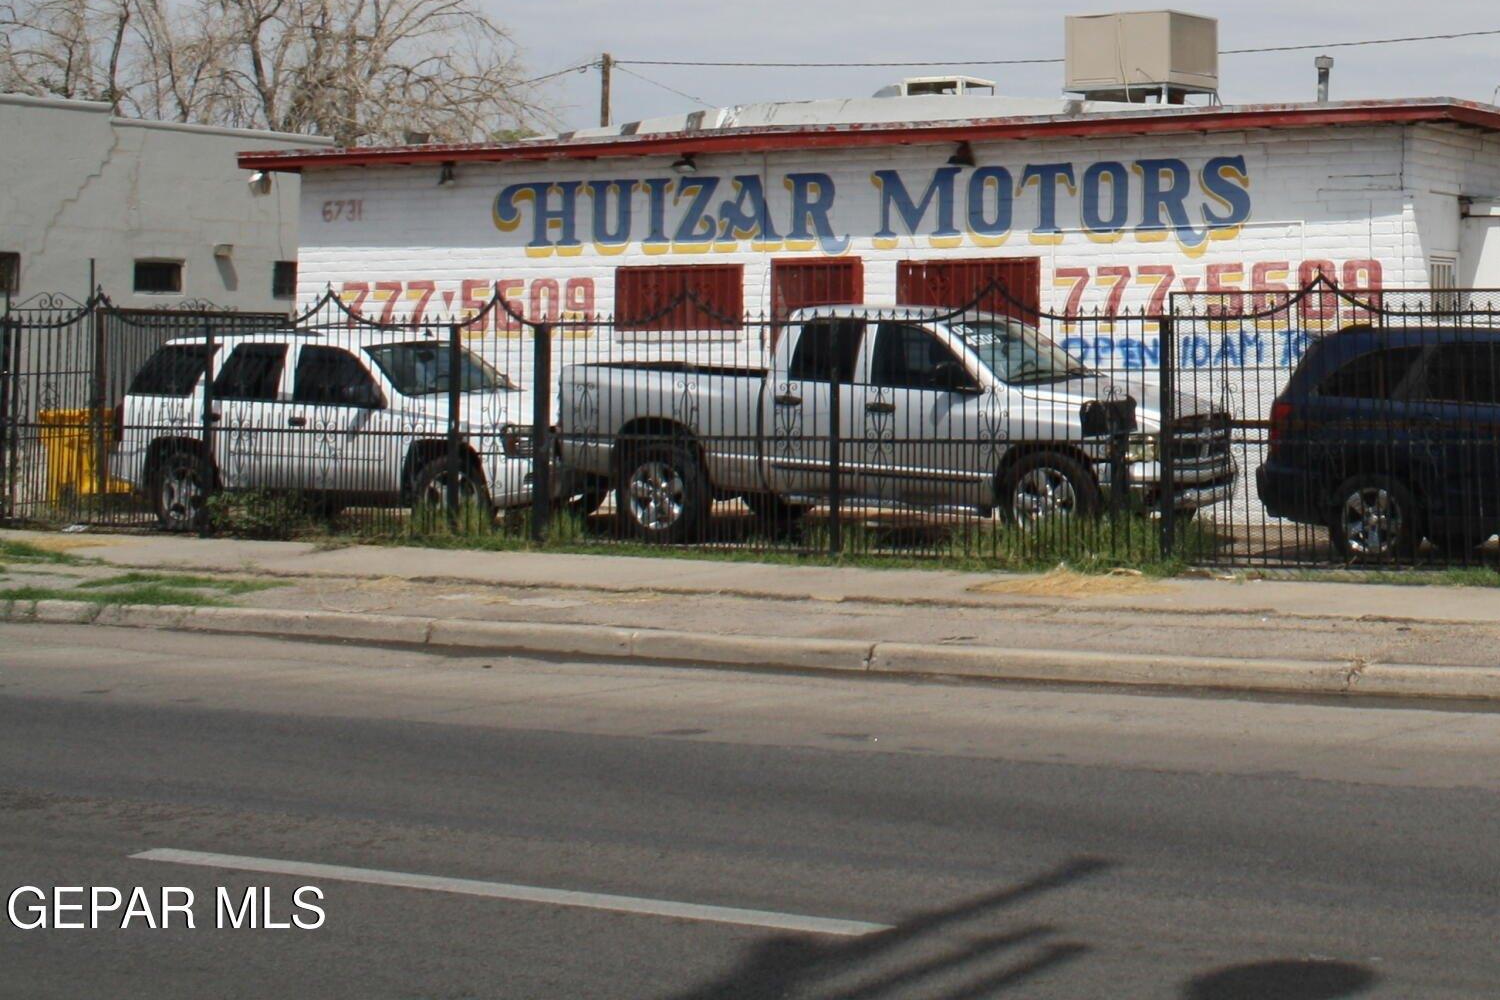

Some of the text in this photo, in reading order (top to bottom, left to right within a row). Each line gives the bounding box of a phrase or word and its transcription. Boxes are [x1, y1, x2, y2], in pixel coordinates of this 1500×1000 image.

[321, 200, 363, 222] 6731
[492, 155, 1251, 257] HUIZAR MOTORS
[1060, 336, 1159, 369] OPEN
